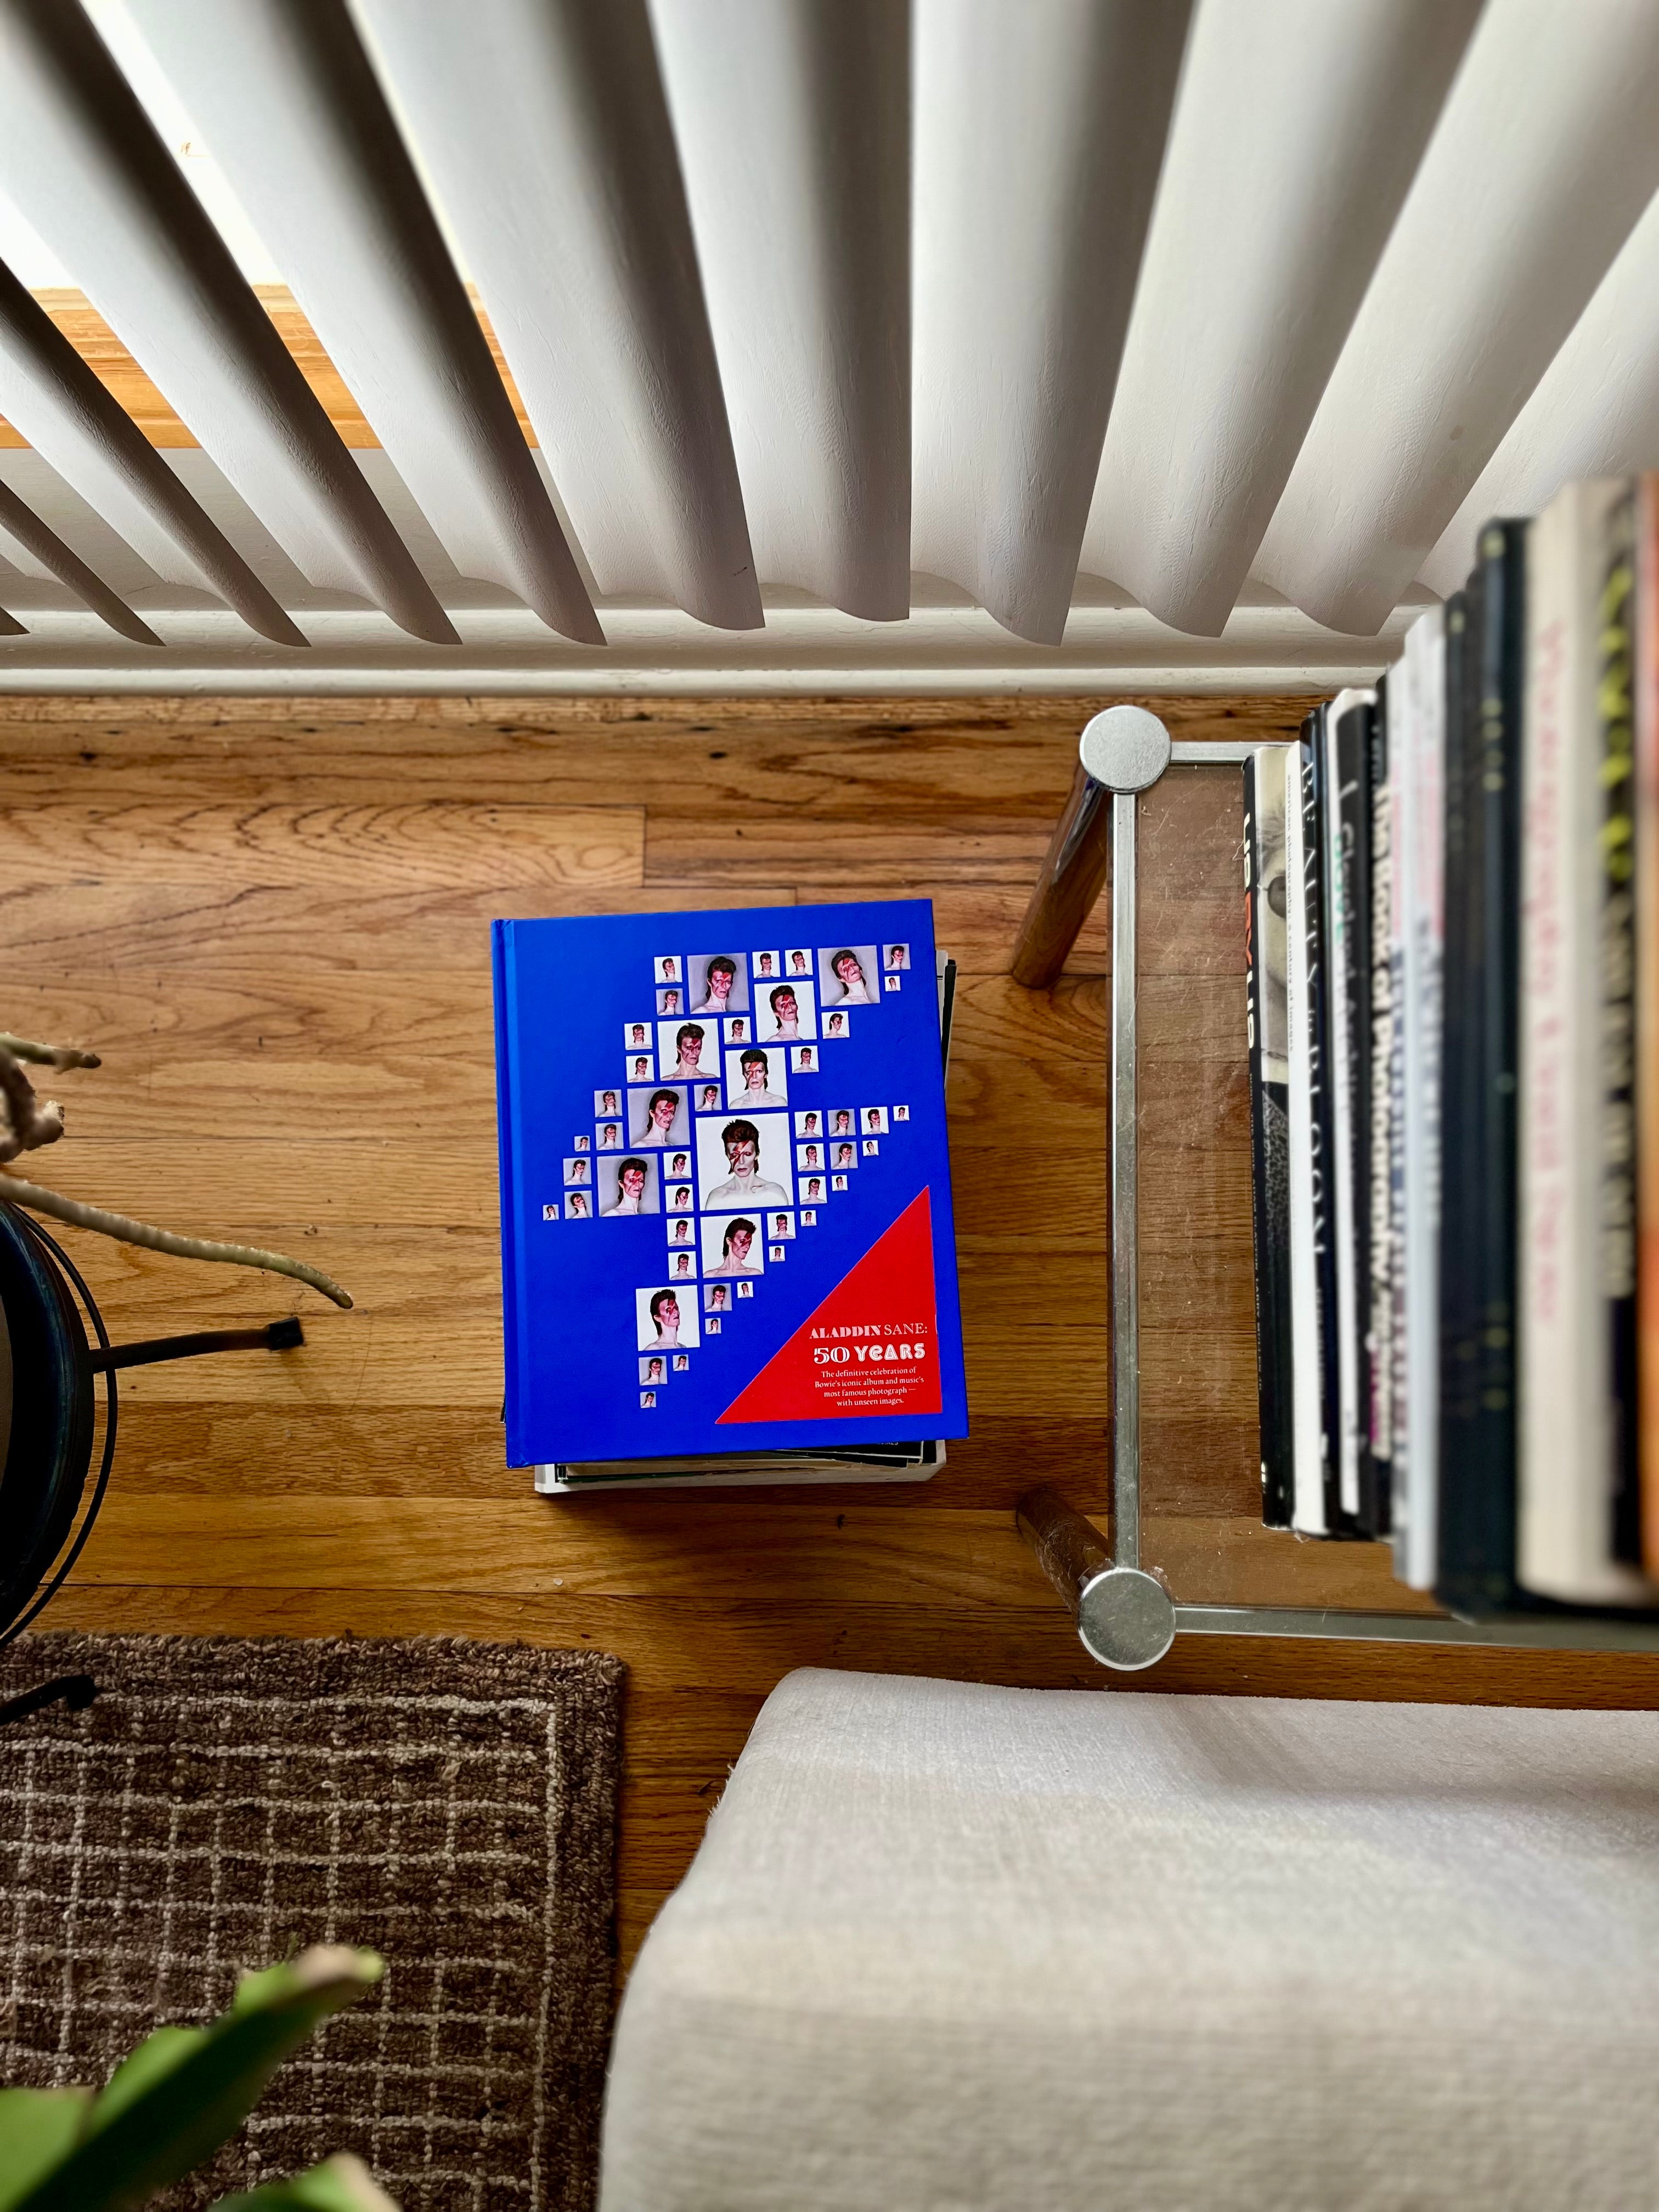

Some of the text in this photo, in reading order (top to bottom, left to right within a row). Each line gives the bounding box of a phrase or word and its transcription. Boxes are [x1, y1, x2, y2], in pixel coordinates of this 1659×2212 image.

[1302, 762, 1319, 988] BEAUTY
[809, 1323, 928, 1339] ALADDIN SANE:
[814, 1346, 850, 1364] 50
[821, 1365, 917, 1378] The definitive celebration of
[815, 1380, 840, 1388] Bowie's
[863, 1378, 884, 1386] album
[885, 1376, 898, 1385] and
[867, 1386, 907, 1397] photograph
[879, 1397, 904, 1406] images.
